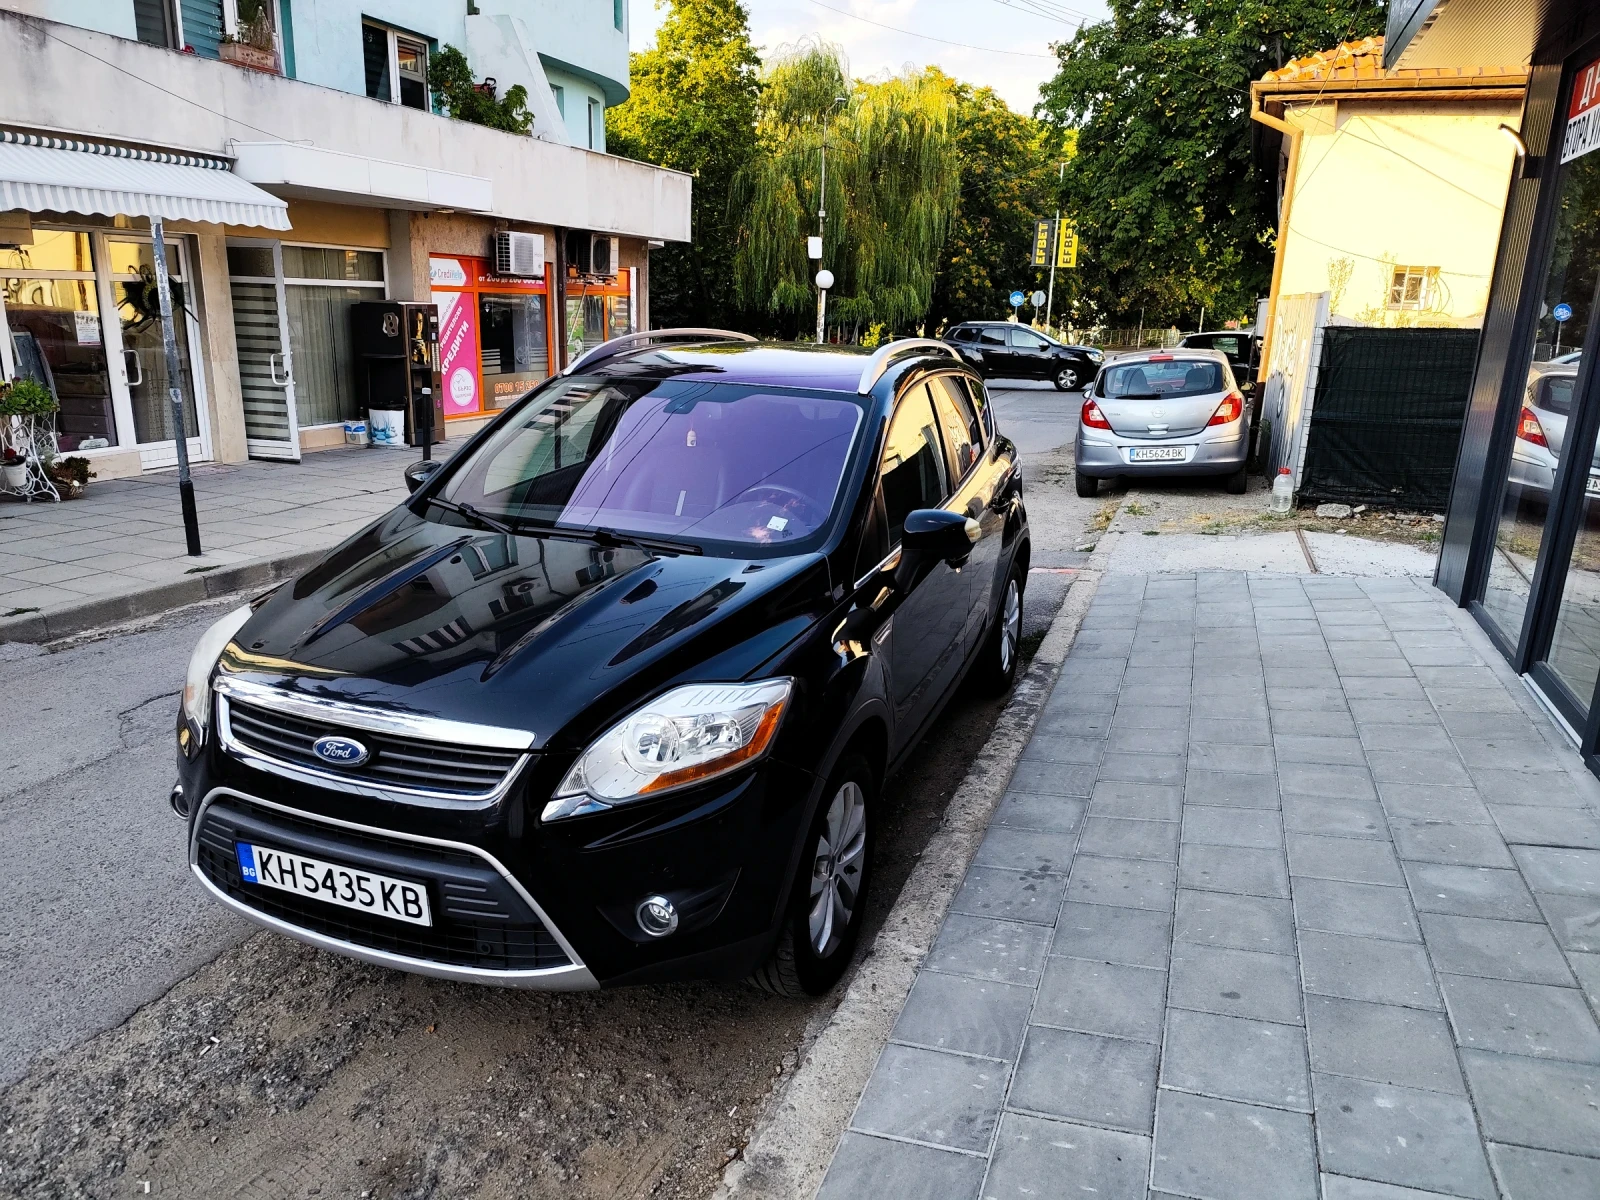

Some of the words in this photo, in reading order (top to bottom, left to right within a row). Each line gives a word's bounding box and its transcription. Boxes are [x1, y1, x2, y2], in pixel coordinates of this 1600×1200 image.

[1563, 113, 1591, 158] ВТОРА
[1035, 222, 1049, 264] EFBET
[441, 320, 469, 375] КРЕДИТИ
[495, 382, 514, 394] 0700
[323, 741, 351, 759] Ford
[242, 866, 256, 877] BG
